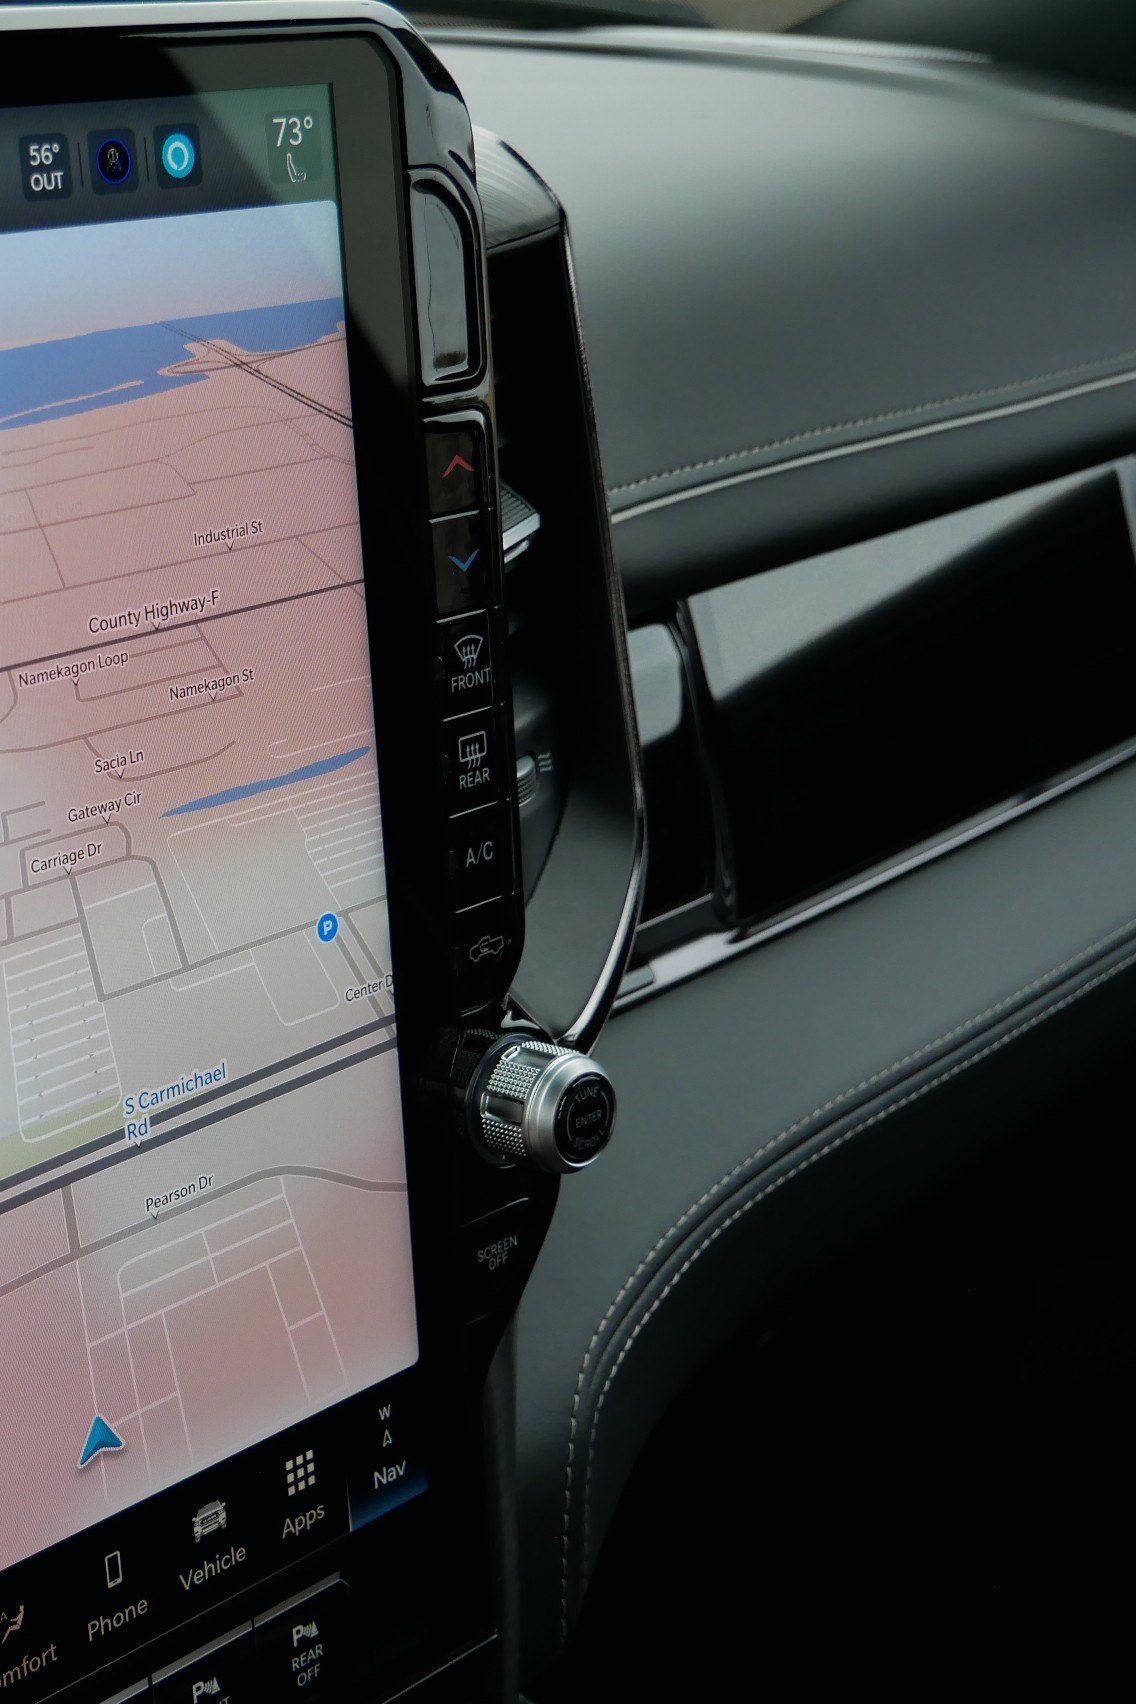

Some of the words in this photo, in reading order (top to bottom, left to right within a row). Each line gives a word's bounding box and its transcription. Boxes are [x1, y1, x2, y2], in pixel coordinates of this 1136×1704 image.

[272, 116, 314, 147] 73°
[28, 144, 60, 166] 56°
[30, 171, 64, 191] OUT
[193, 523, 249, 547] Industrial
[250, 520, 264, 535] St
[88, 609, 141, 634] County
[144, 589, 220, 622] Highway-F
[18, 658, 96, 688] Namekagon
[98, 651, 129, 670] Loop
[450, 667, 491, 693] FRONT
[169, 674, 240, 701] Namekagon
[241, 668, 255, 683] St
[94, 754, 128, 774] Sacia
[129, 750, 145, 765] Ln
[458, 766, 490, 790] REAR
[67, 800, 123, 823] Gateway
[124, 791, 142, 809] Cir
[30, 847, 86, 874] Carriage
[87, 840, 103, 857] Dr
[465, 841, 494, 868] A/C
[345, 980, 383, 1002] Center
[124, 1097, 136, 1116] S
[137, 1062, 227, 1109] Carmichael
[574, 1086, 600, 1103] TUNE
[126, 1118, 149, 1140] Rd
[575, 1109, 602, 1129] ENTER
[145, 1182, 197, 1212] Pearson
[198, 1174, 215, 1191] Dr
[477, 1235, 518, 1263] SCREEN
[488, 1254, 508, 1271] OFF
[378, 1404, 392, 1420] W
[373, 1460, 407, 1489] Nav
[281, 1504, 326, 1539] Apps
[179, 1546, 246, 1590] Vehicle
[87, 1599, 148, 1642] Phone
[291, 1643, 324, 1671] REAR
[297, 1663, 321, 1687] OFF
